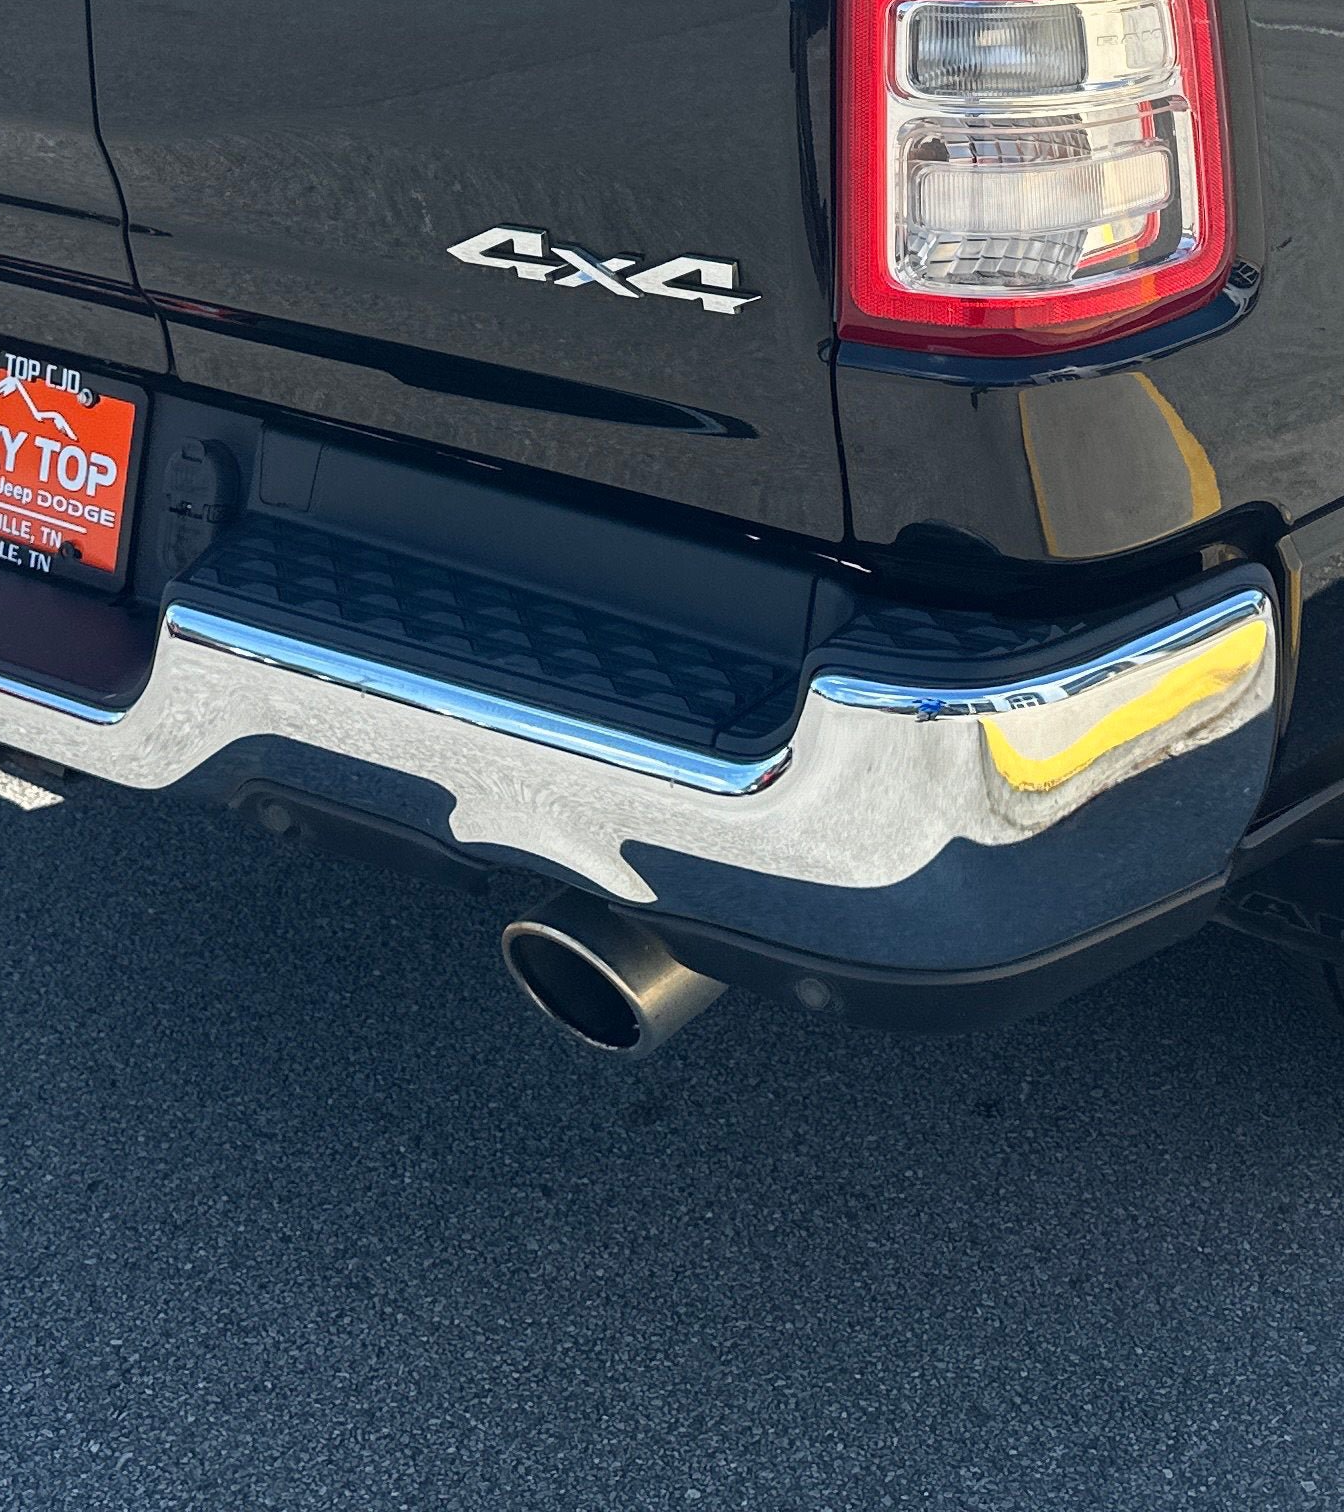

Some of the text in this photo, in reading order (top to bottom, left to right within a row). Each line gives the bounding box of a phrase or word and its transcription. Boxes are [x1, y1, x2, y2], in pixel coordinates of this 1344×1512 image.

[5, 353, 40, 382] TOP
[45, 364, 80, 394] CJD
[34, 436, 117, 496] TOP
[36, 489, 116, 528] DODGE
[40, 526, 62, 549] TN
[29, 549, 51, 573] TN
